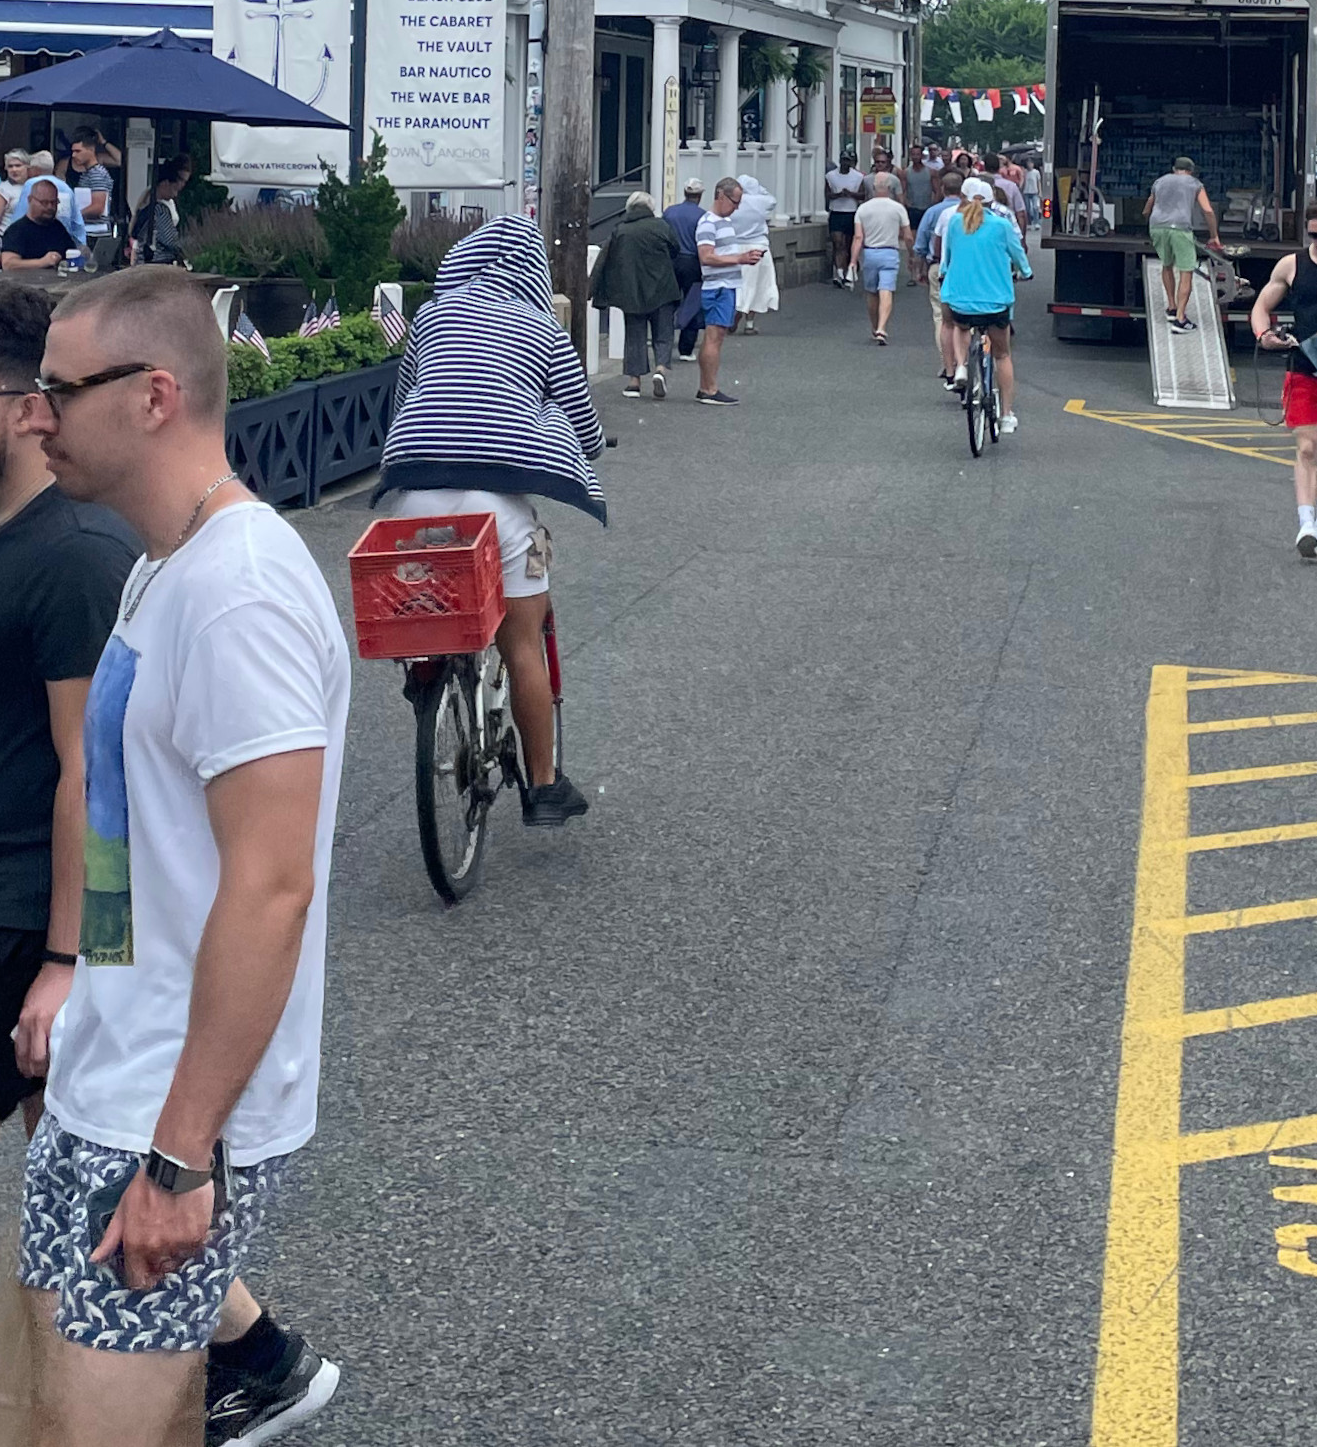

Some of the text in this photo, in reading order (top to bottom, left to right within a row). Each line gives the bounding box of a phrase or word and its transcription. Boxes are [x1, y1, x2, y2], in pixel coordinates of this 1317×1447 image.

[400, 15, 493, 28] THE CABARET
[417, 41, 493, 53] THE VAULT
[399, 66, 492, 79] BAR NAUTICO
[390, 91, 491, 104] THE WAVE BAR
[376, 117, 491, 130] THE PARAMOUNT
[387, 147, 491, 159] OWN ANCHOR
